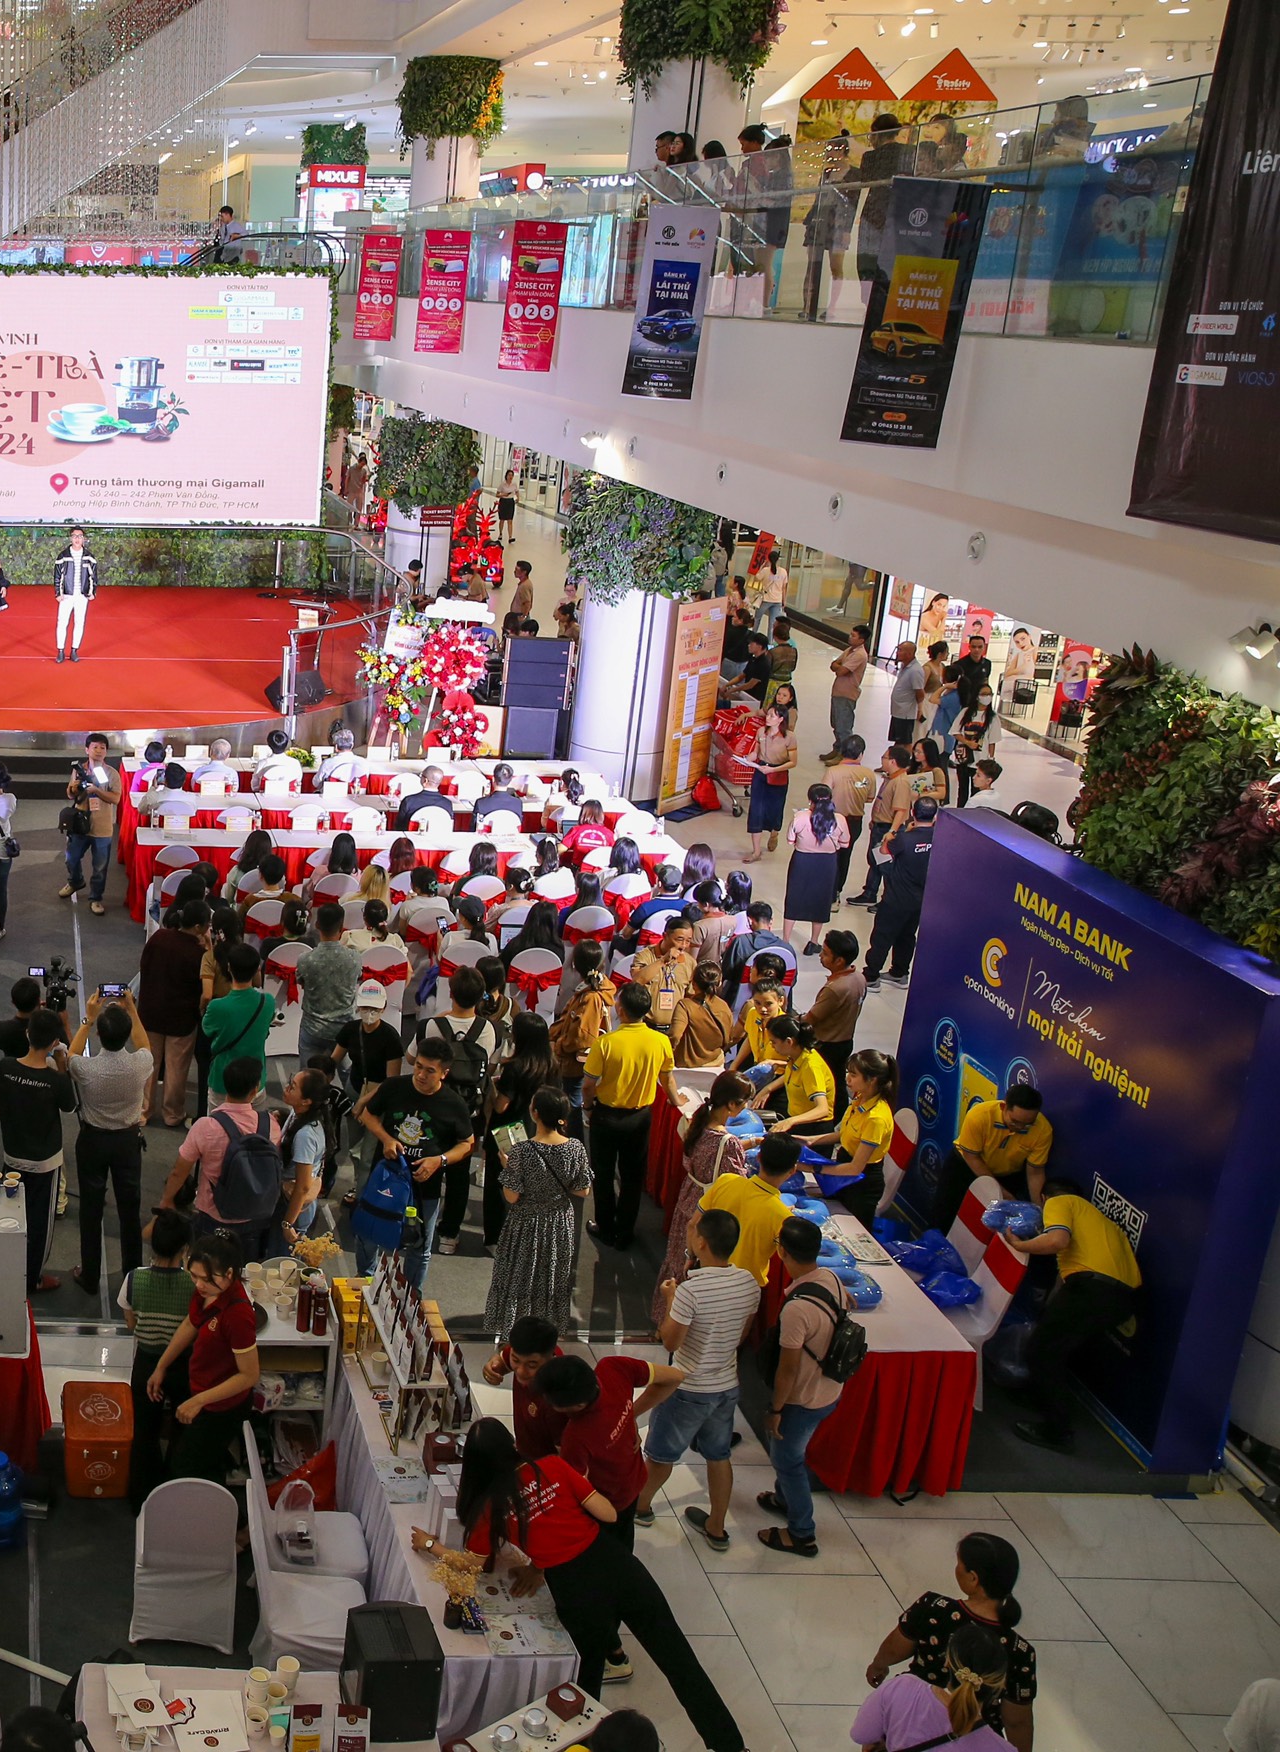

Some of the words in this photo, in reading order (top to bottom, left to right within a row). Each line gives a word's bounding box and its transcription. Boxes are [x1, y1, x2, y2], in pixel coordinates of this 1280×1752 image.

[316, 170, 360, 184] MIXUE
[514, 281, 537, 289] SENSE
[538, 283, 555, 291] CITY
[73, 477, 108, 489] Trung
[111, 477, 134, 487] tâm
[137, 477, 183, 489] thương
[186, 478, 208, 489] mại
[211, 478, 265, 490] Gigamall
[104, 490, 120, 498] 240
[129, 490, 146, 498] 242
[148, 490, 174, 499] Phạm
[167, 500, 179, 508] TP
[223, 501, 235, 509] TP
[237, 501, 259, 509] HCM
[1014, 882, 1057, 926] NAM
[1058, 914, 1072, 935] A
[1073, 918, 1133, 972] BANK
[1020, 915, 1038, 935] Ngân
[1038, 925, 1056, 947] hàng
[1056, 933, 1070, 955] Đẹp
[1074, 948, 1090, 969] Dịch
[1090, 959, 1101, 975] vụ
[1101, 961, 1114, 982] Tốt
[963, 973, 984, 998] open
[983, 985, 1016, 1020] banking
[1034, 970, 1072, 1015] Một
[1068, 1006, 1106, 1042] chạm
[1027, 1008, 1054, 1043] mọi
[1056, 1025, 1081, 1060] trải
[1084, 1048, 1151, 1110] nghiệm!
[408, 1148, 423, 1158] LIFE
